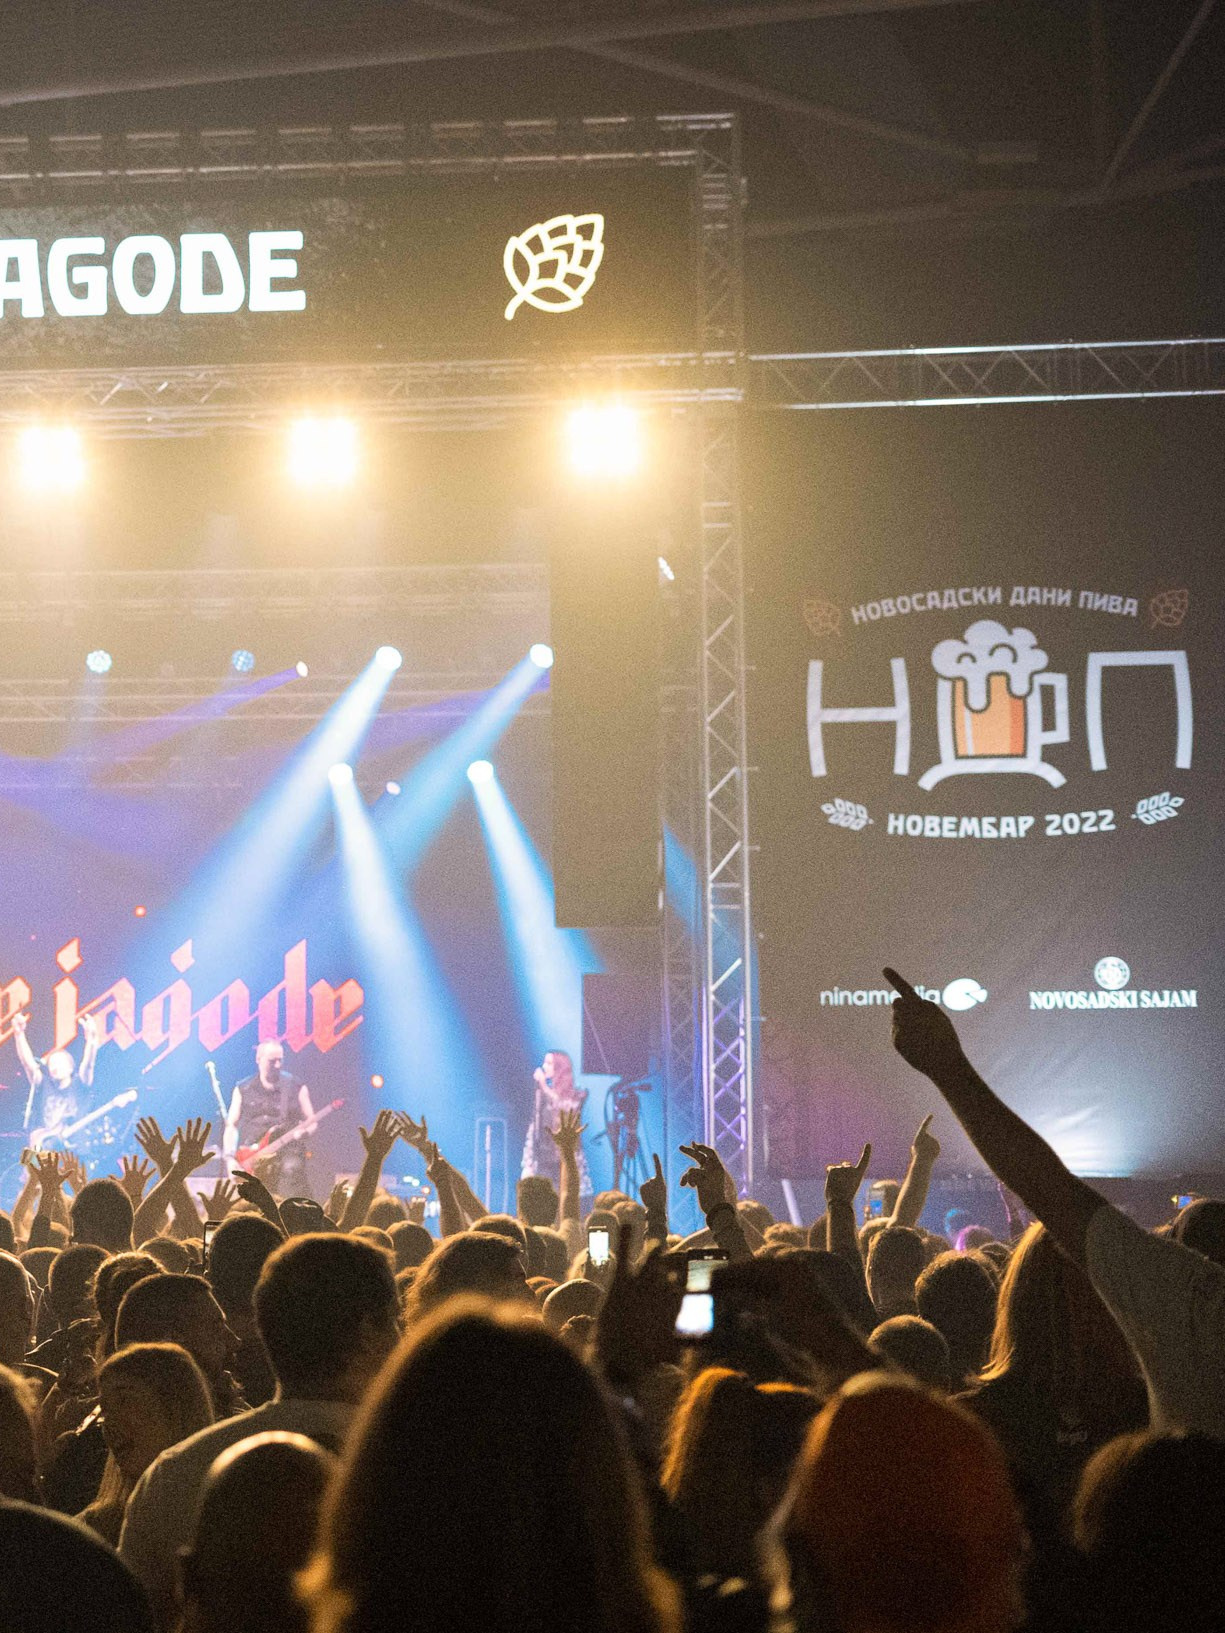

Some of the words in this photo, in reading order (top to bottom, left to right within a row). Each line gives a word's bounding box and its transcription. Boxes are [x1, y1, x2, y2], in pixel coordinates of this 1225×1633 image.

[851, 585, 1003, 625] НОВОСАДСКИ
[1009, 586, 1072, 607] ДАНИ
[1078, 590, 1139, 618] ПИВА
[886, 813, 1035, 839] НОВЕМБАР
[1044, 809, 1116, 837] 2022
[1029, 990, 1138, 1010] NOVOSADSKI
[1139, 988, 1198, 1008] SAJAM
